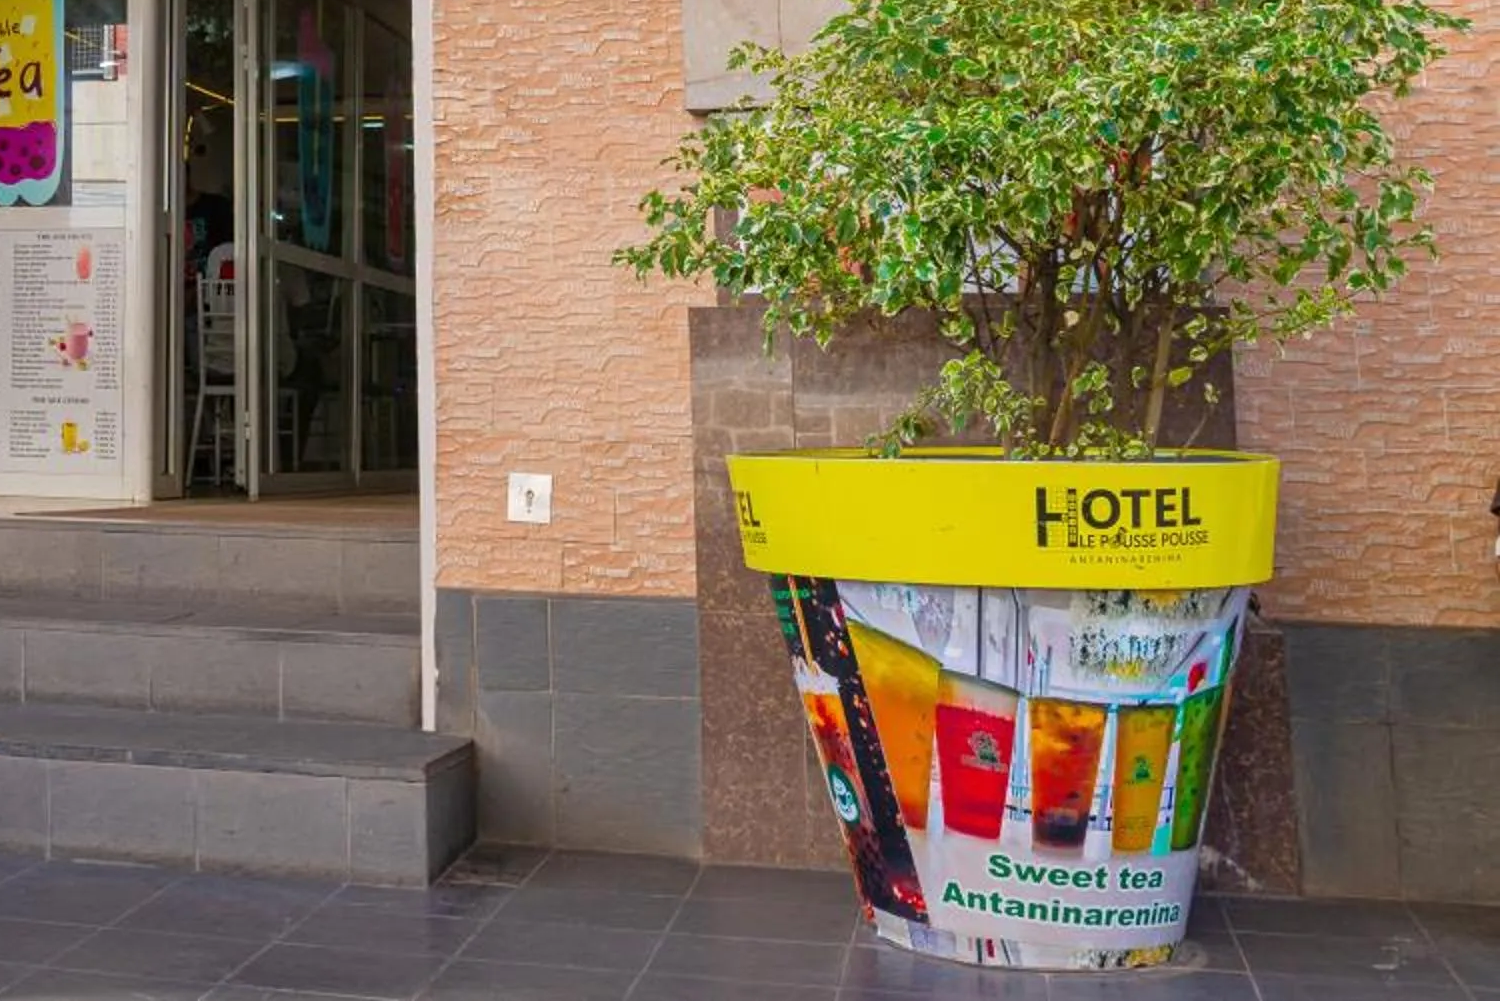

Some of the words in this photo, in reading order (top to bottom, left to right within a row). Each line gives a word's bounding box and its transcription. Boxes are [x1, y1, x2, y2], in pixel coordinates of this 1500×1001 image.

[1036, 487, 1203, 547] HOTEL
[1079, 535, 1093, 548] LE
[1162, 530, 1209, 546] POUSSE
[989, 854, 1108, 889] Sweet
[1119, 867, 1164, 889] tea
[942, 882, 1180, 926] Antaninarenina
